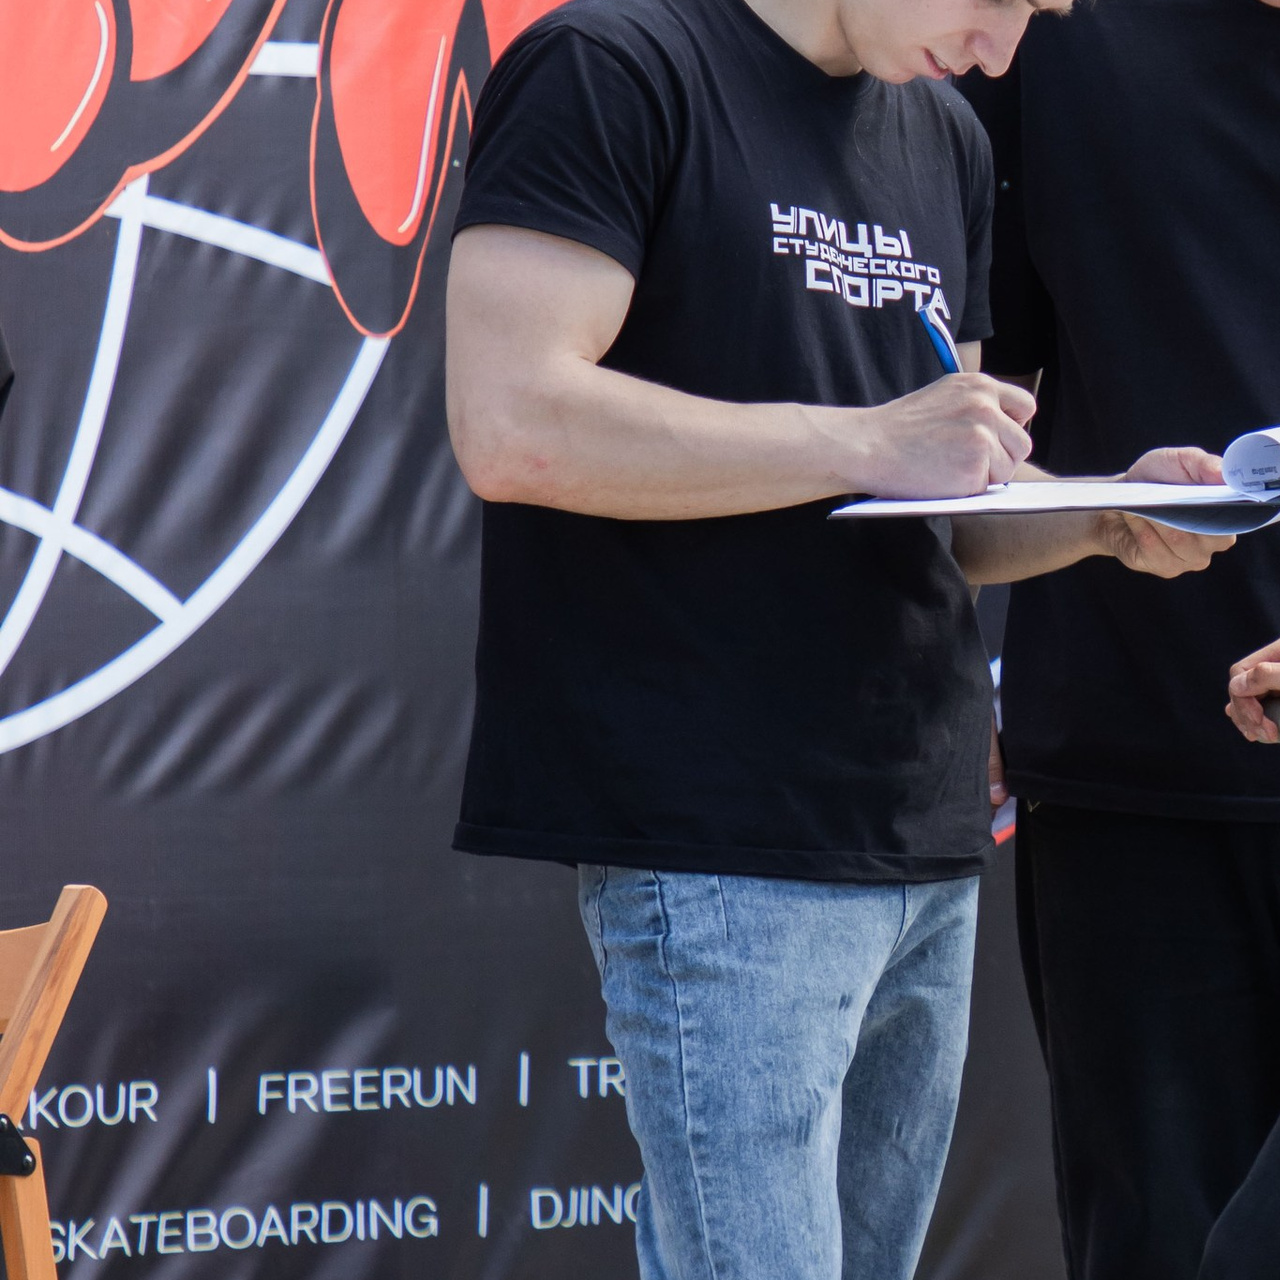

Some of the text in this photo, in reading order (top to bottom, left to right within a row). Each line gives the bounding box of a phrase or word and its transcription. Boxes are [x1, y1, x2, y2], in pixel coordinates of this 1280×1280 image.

[805, 259, 951, 320] СПОРТА
[17, 1079, 158, 1131] KOUR
[258, 1063, 478, 1115] FREERUN
[49, 1194, 438, 1263] SKATEBOARDING
